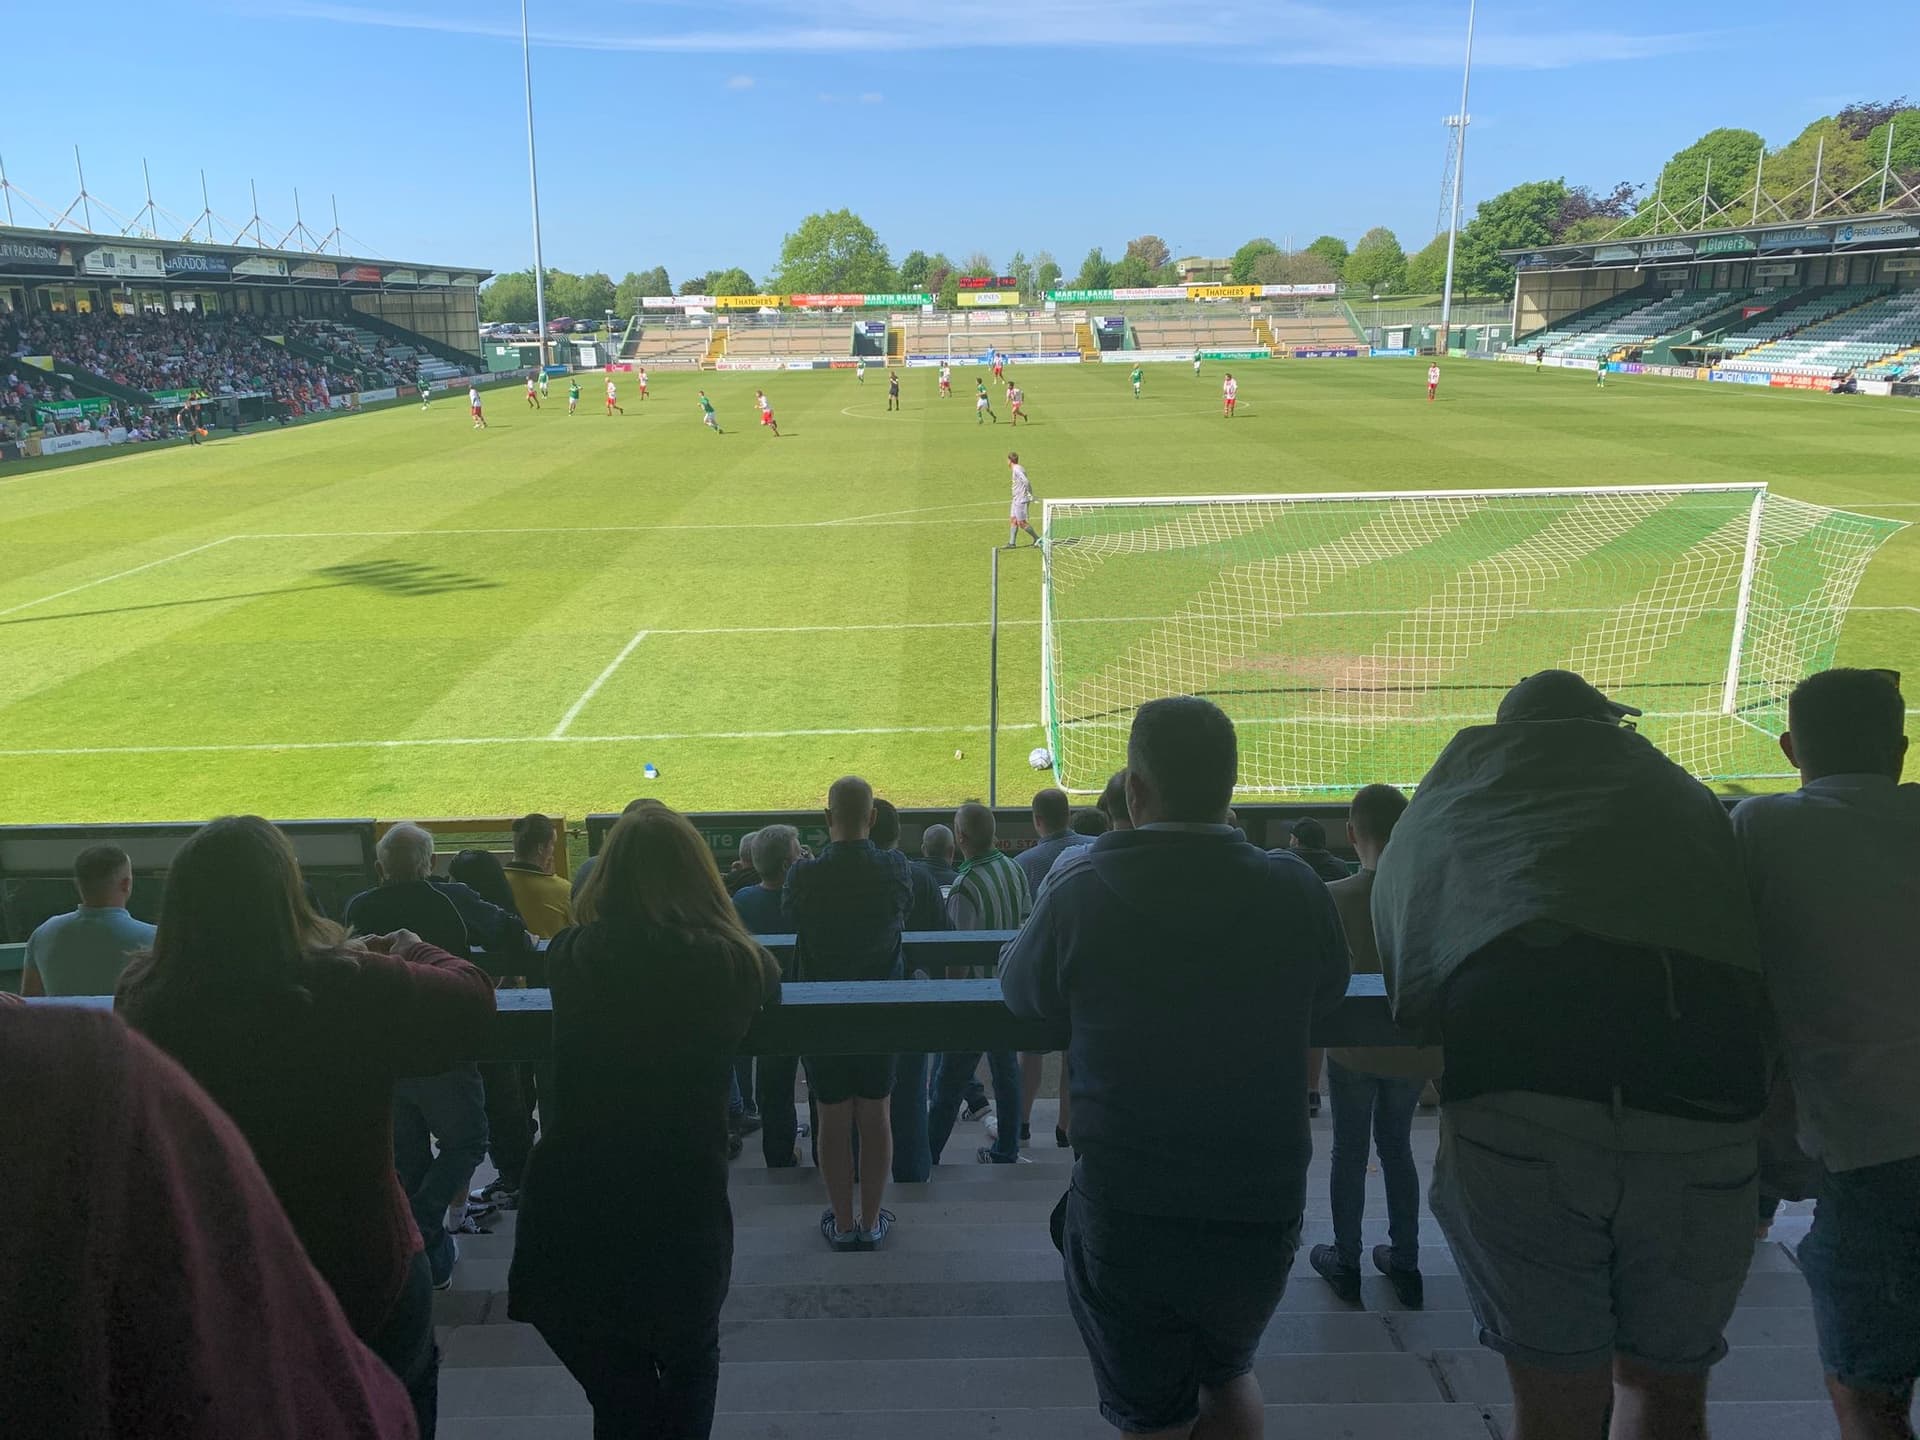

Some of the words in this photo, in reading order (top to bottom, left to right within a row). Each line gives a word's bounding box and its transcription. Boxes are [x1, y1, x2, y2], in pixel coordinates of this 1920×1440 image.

[1708, 238, 1744, 250] Glovers
[14, 246, 57, 259] PACKAGING
[1087, 289, 1113, 297] BAKER
[1206, 287, 1245, 297] THATCHERS
[735, 297, 773, 306] THATCHERS
[864, 293, 895, 302] MARTIN
[896, 293, 922, 302] BAKER
